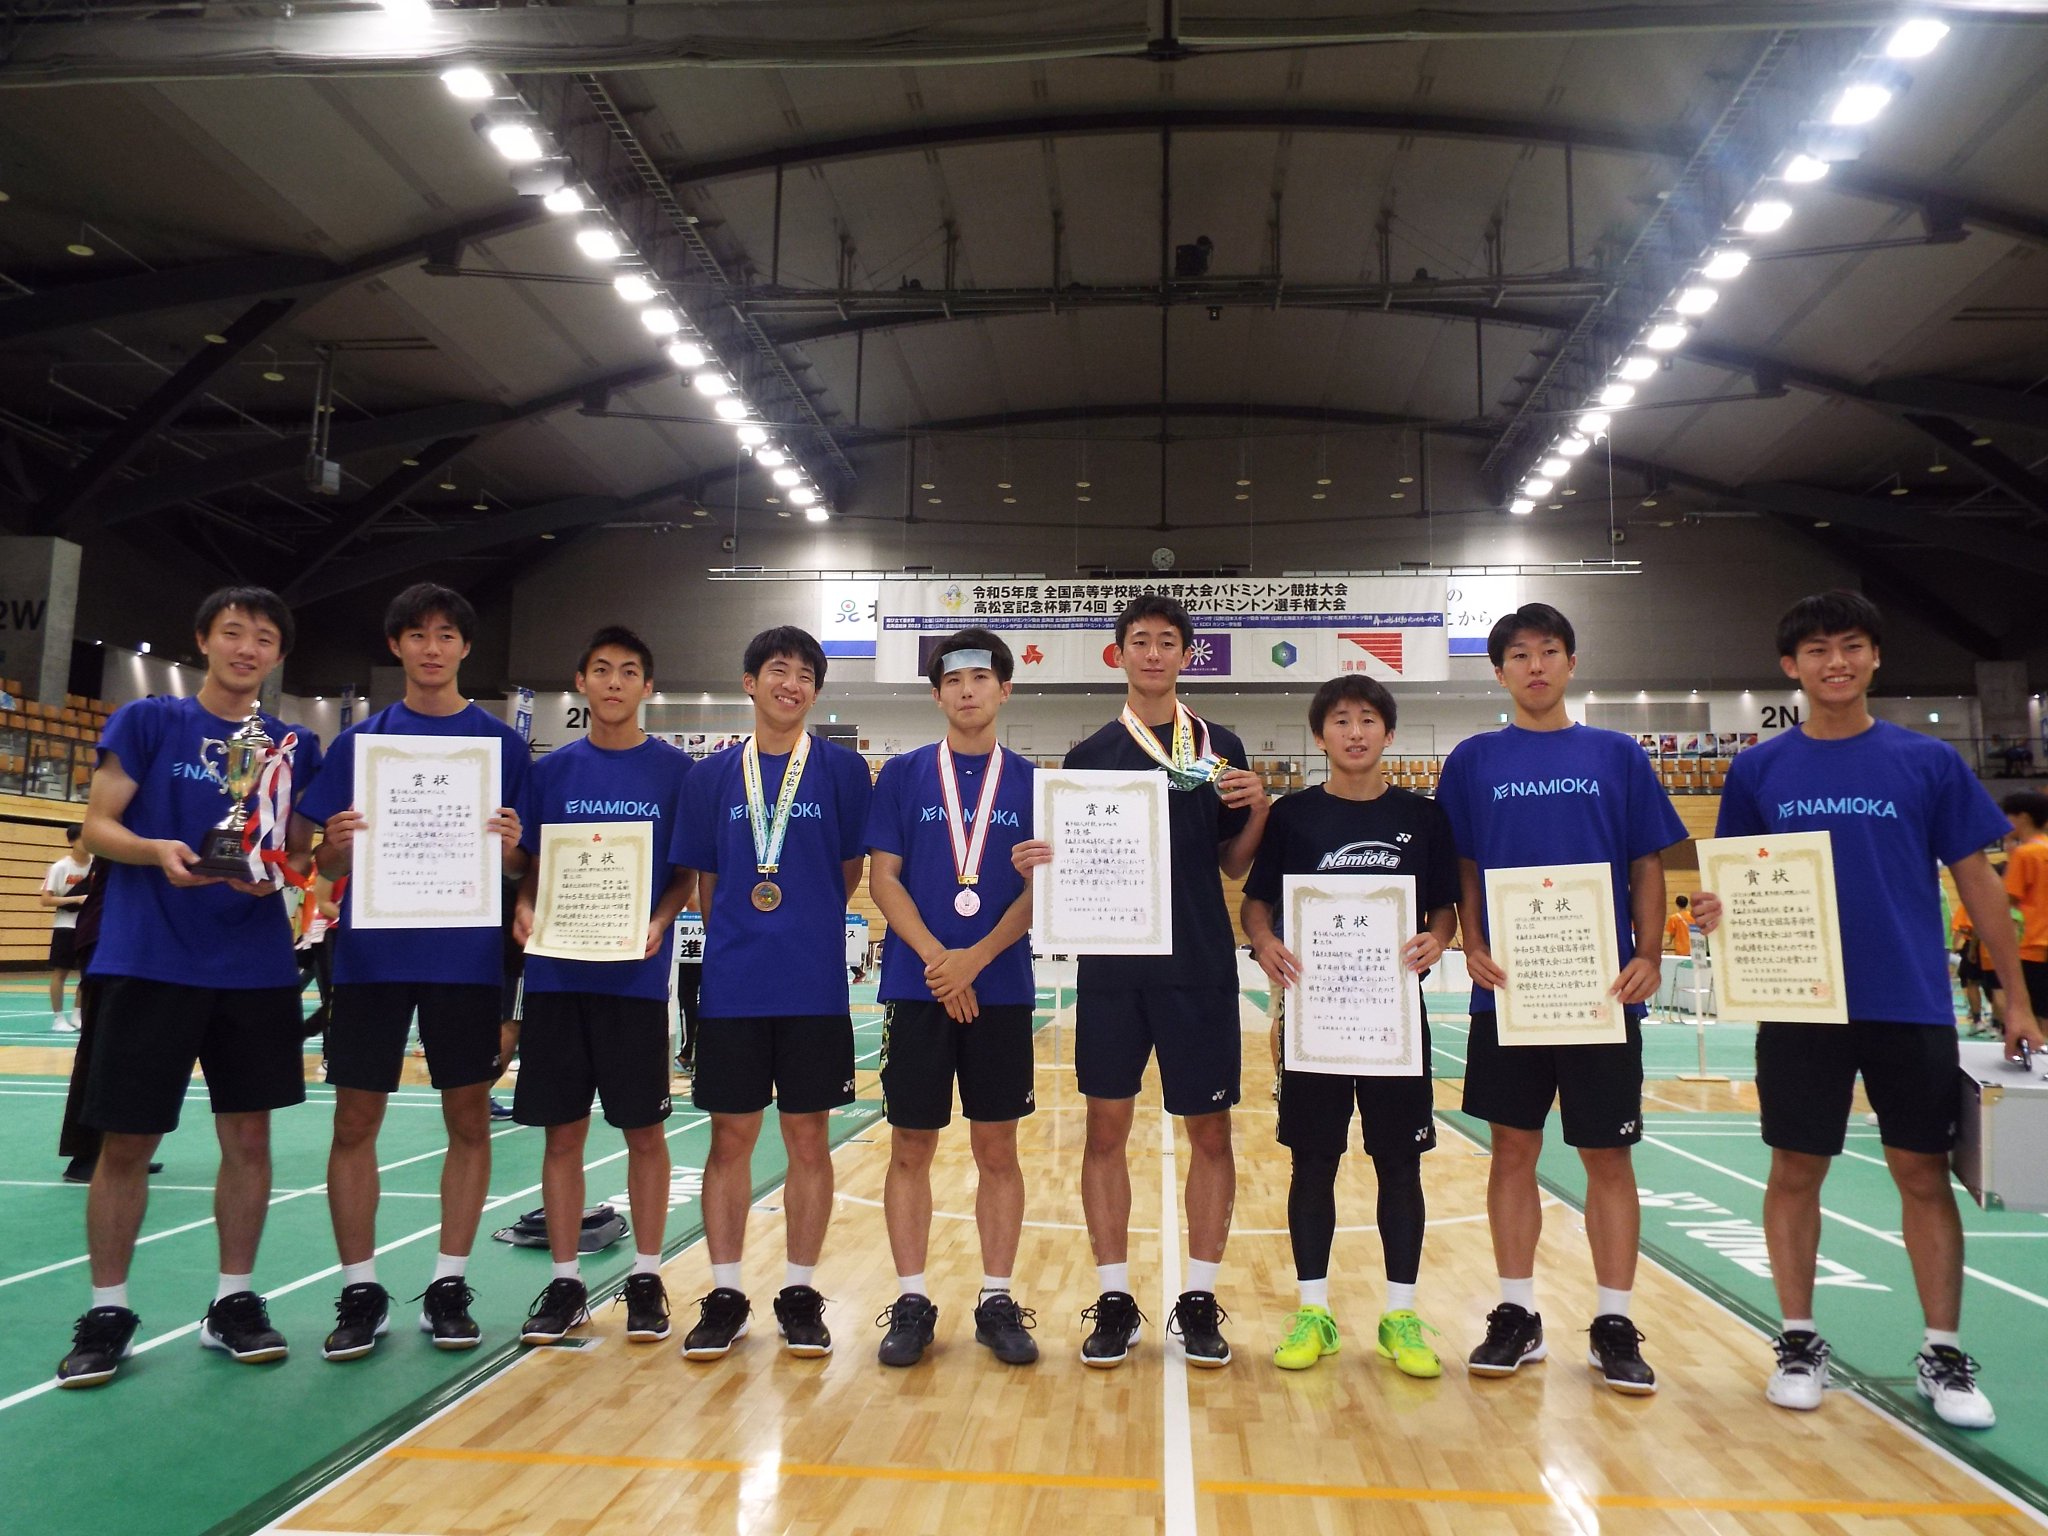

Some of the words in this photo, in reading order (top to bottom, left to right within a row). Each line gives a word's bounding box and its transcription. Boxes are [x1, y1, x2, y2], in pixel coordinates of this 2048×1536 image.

[972, 585, 1039, 599] 令和5年度
[1044, 583, 1348, 599] 全国高等学校総合体育大会バドミントン競技大会
[973, 600, 1107, 614] 高松宮記念杯第74回
[1112, 597, 1346, 613] 全校バドミントン選手権大会
[1761, 705, 1799, 729] 2N
[1511, 777, 1600, 797] NAMIOKA
[579, 800, 661, 819] NAMIOKA
[746, 802, 822, 820] AOKA
[939, 806, 1019, 828] NMOKA
[1086, 803, 1120, 816] 賞状
[1798, 797, 1897, 819] NAMIOKA
[578, 851, 615, 866] 賞状
[1318, 850, 1400, 870] Namioka
[1745, 868, 1789, 886] 賞状
[1529, 897, 1572, 914] 賞状
[1332, 914, 1369, 929] 賞状
